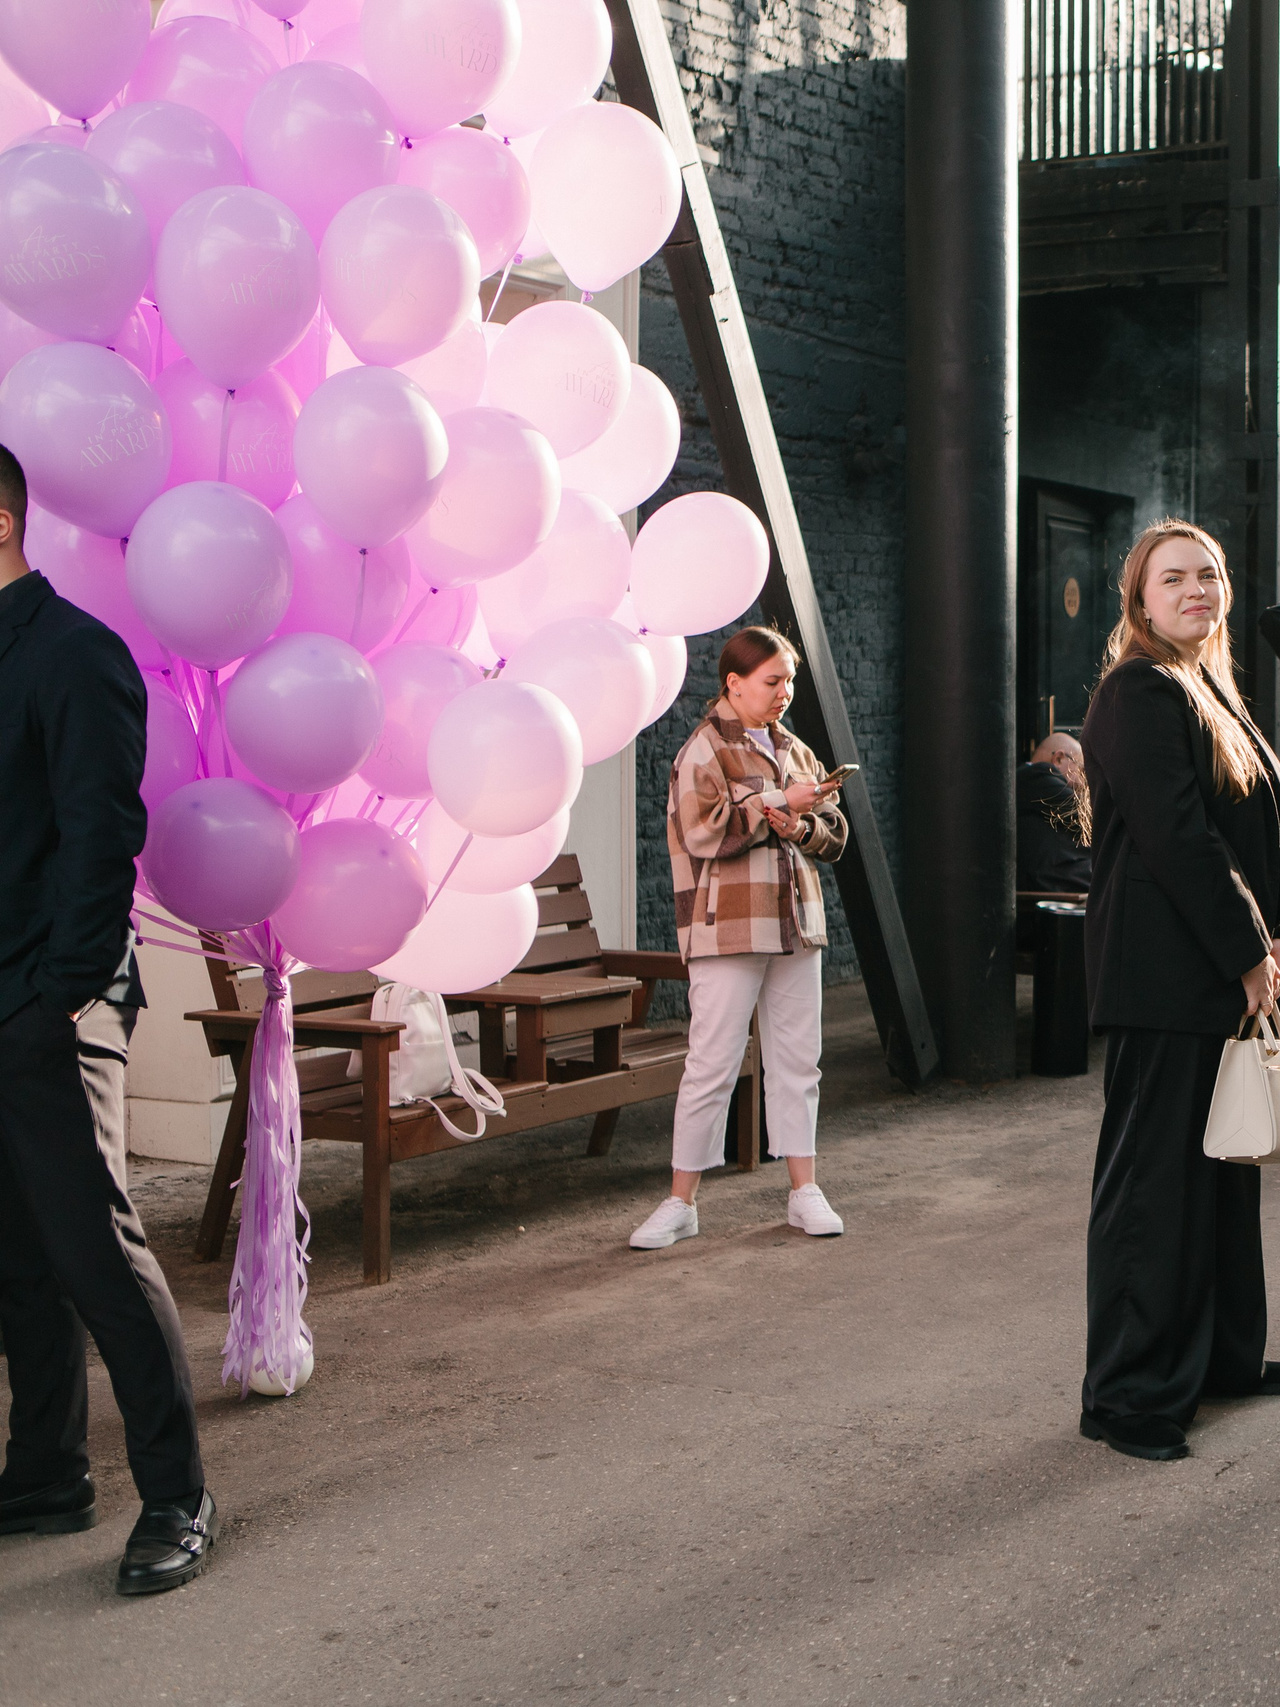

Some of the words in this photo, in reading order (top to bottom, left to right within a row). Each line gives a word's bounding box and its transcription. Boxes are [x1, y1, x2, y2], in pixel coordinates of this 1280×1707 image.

[34, 241, 79, 258] PARTY
[4, 245, 106, 285] AWARDS
[111, 415, 146, 436] PARTY
